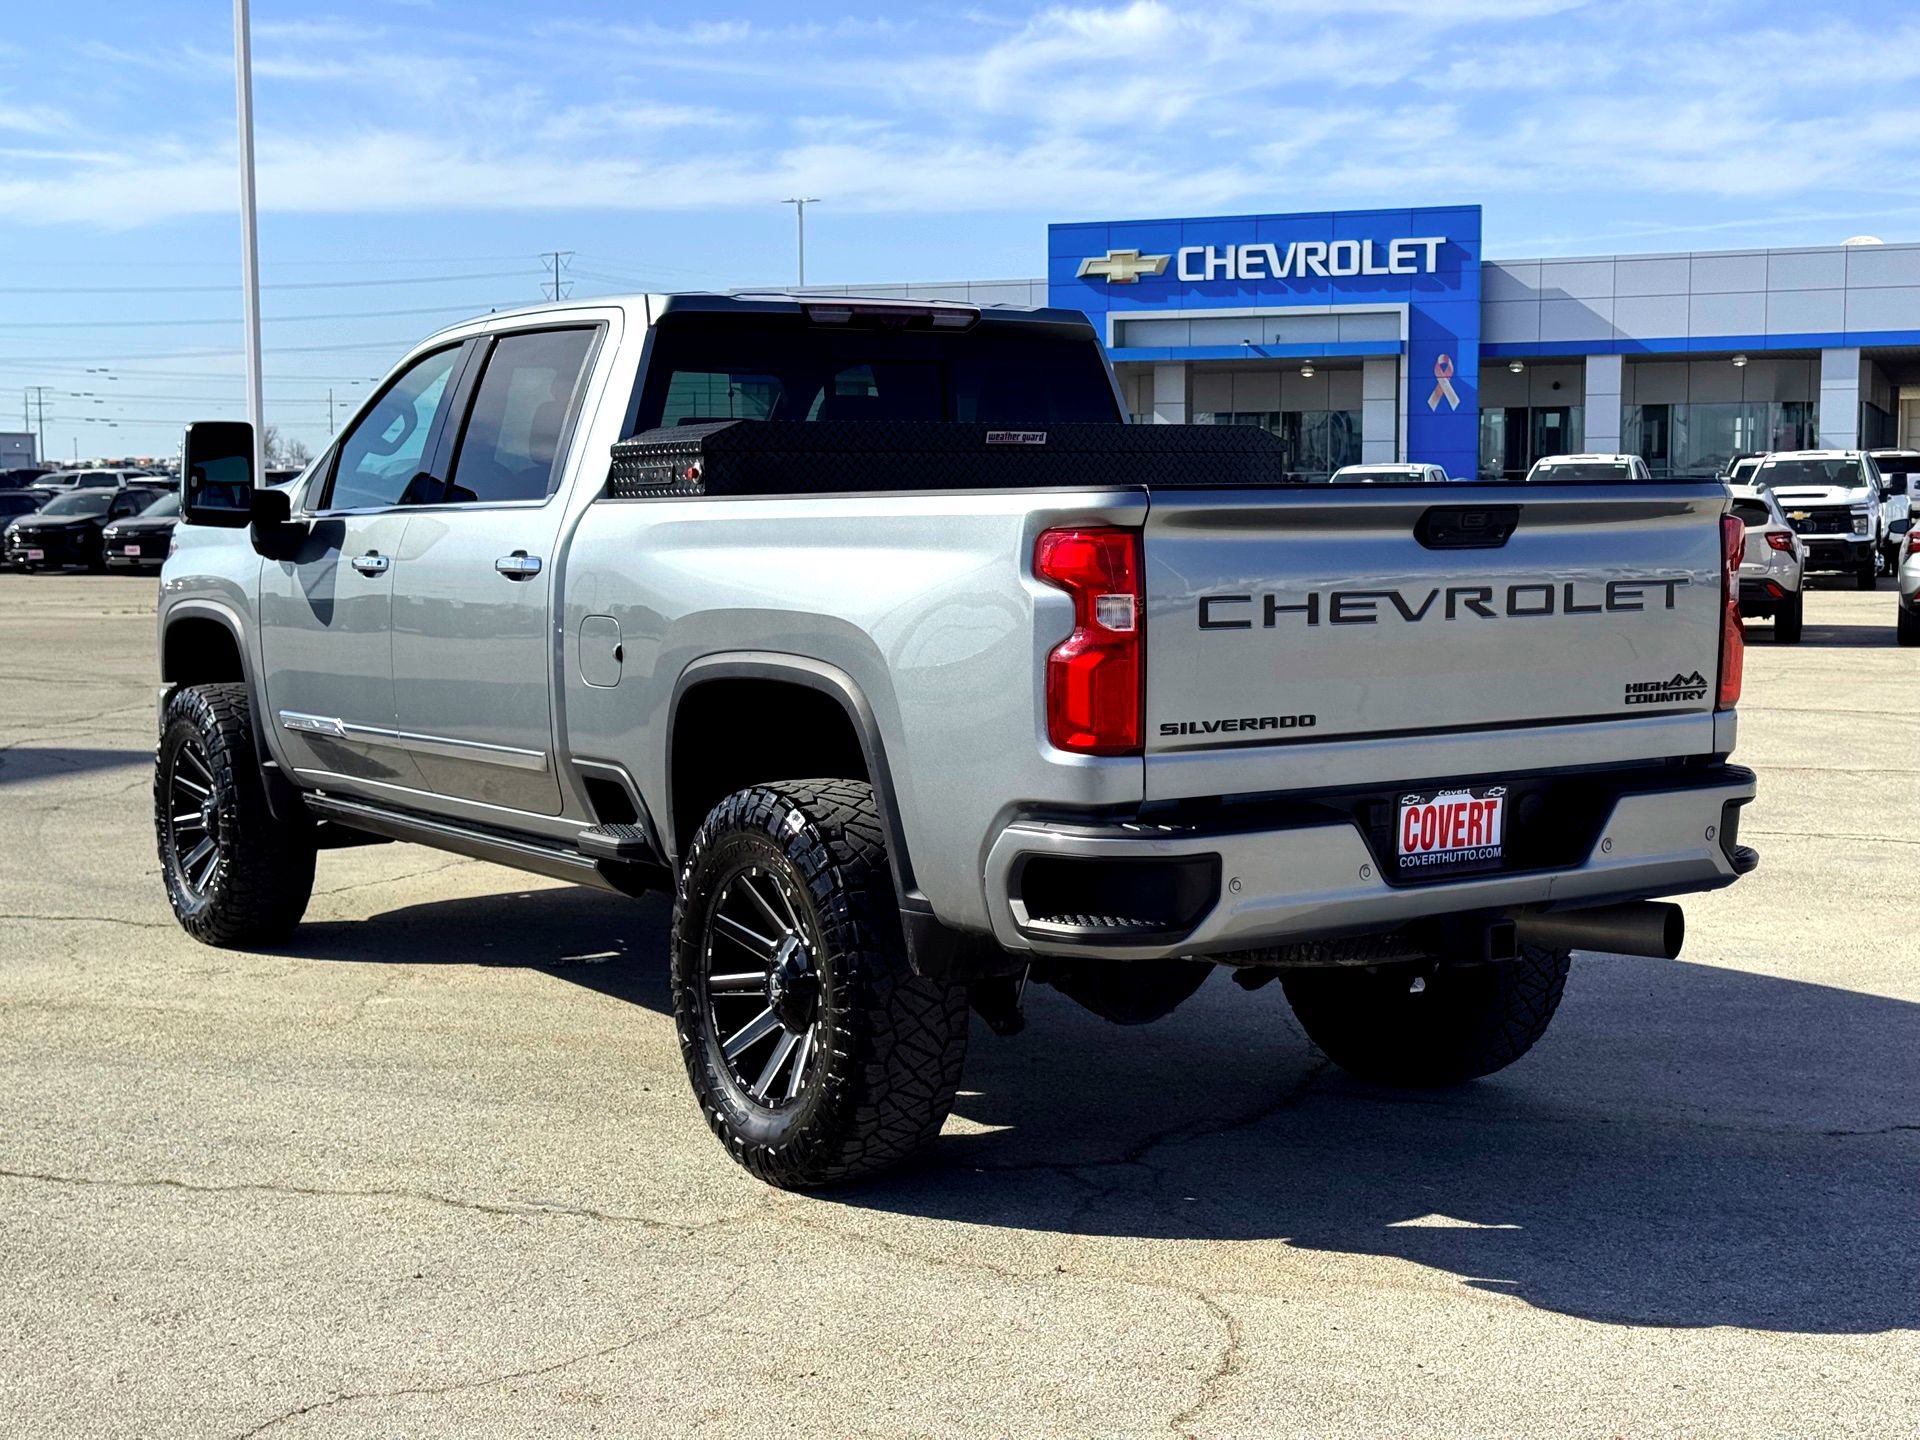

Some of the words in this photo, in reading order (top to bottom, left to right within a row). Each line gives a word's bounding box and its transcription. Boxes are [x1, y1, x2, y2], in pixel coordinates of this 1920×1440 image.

[1178, 236, 1447, 282] CHEVROLET
[988, 432, 1020, 441] weather
[1022, 432, 1045, 442] guard
[1198, 578, 1690, 629] CHEVROLET
[1625, 681, 1669, 693] HIGH
[1625, 689, 1707, 704] COUNTRY
[1160, 714, 1317, 736] SILVERADO
[1438, 788, 1471, 796] Covert
[1403, 800, 1498, 853] COVERT
[1400, 847, 1502, 867] COVERTHUTTO.COM
